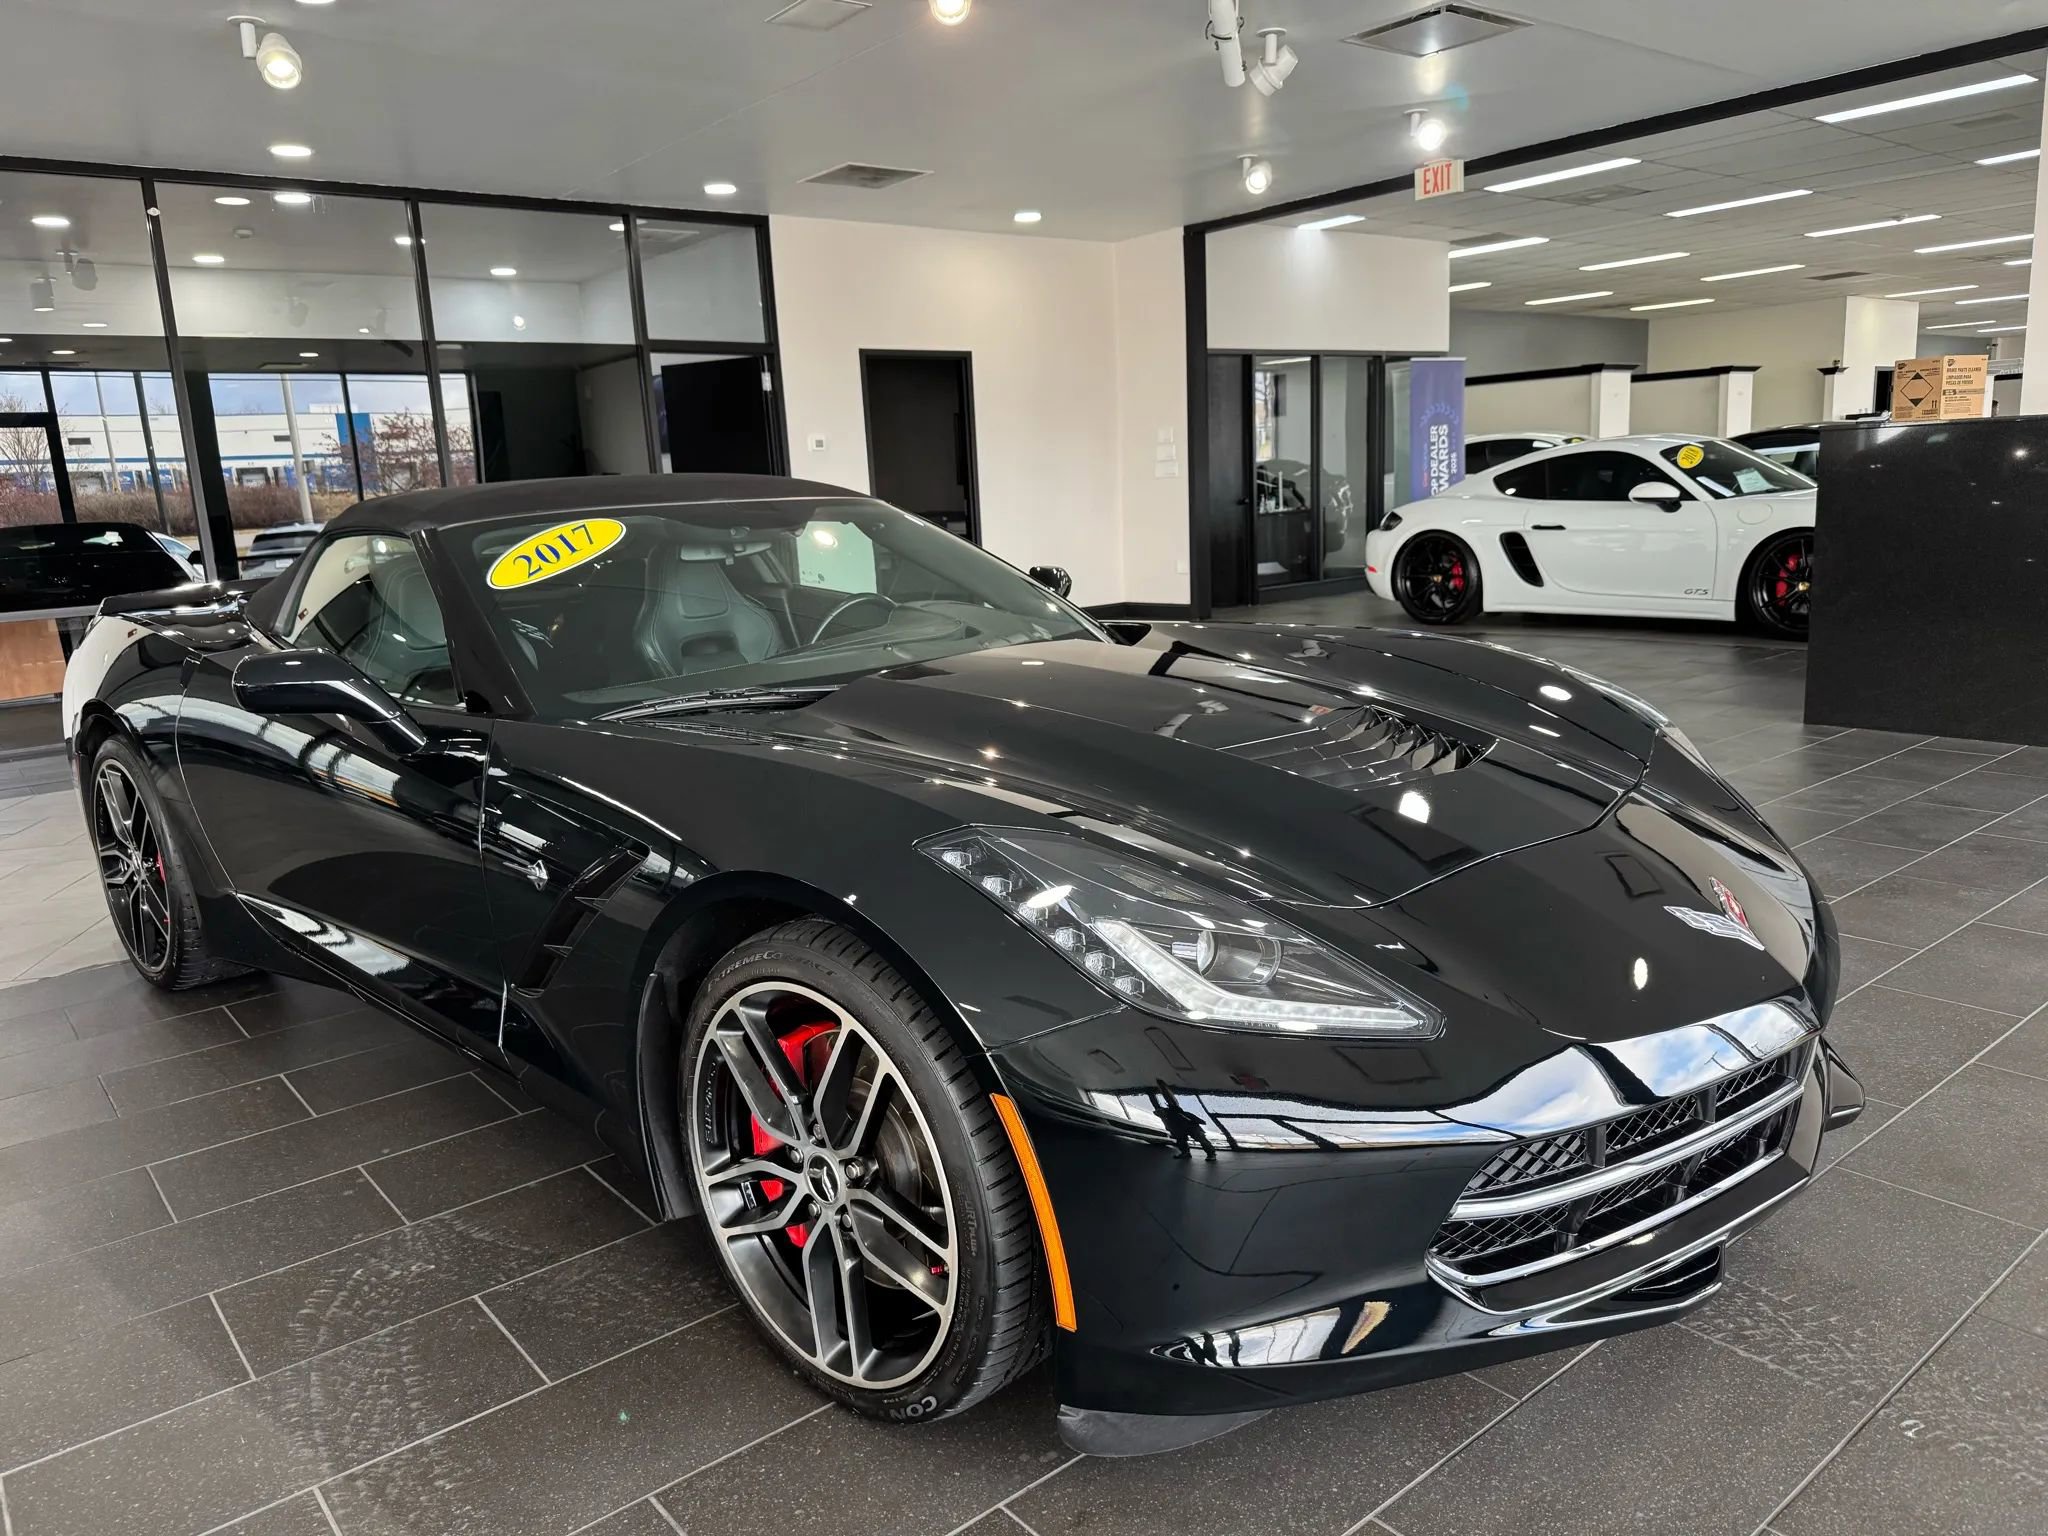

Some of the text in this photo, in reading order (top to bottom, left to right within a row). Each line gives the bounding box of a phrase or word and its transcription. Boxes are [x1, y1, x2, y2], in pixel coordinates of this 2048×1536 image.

[1423, 162, 1453, 195] EXIT
[1430, 425, 1439, 496] OP DEALER
[1438, 424, 1449, 491] WARDS
[513, 524, 594, 578] 2017
[1683, 588, 1709, 596] GTS
